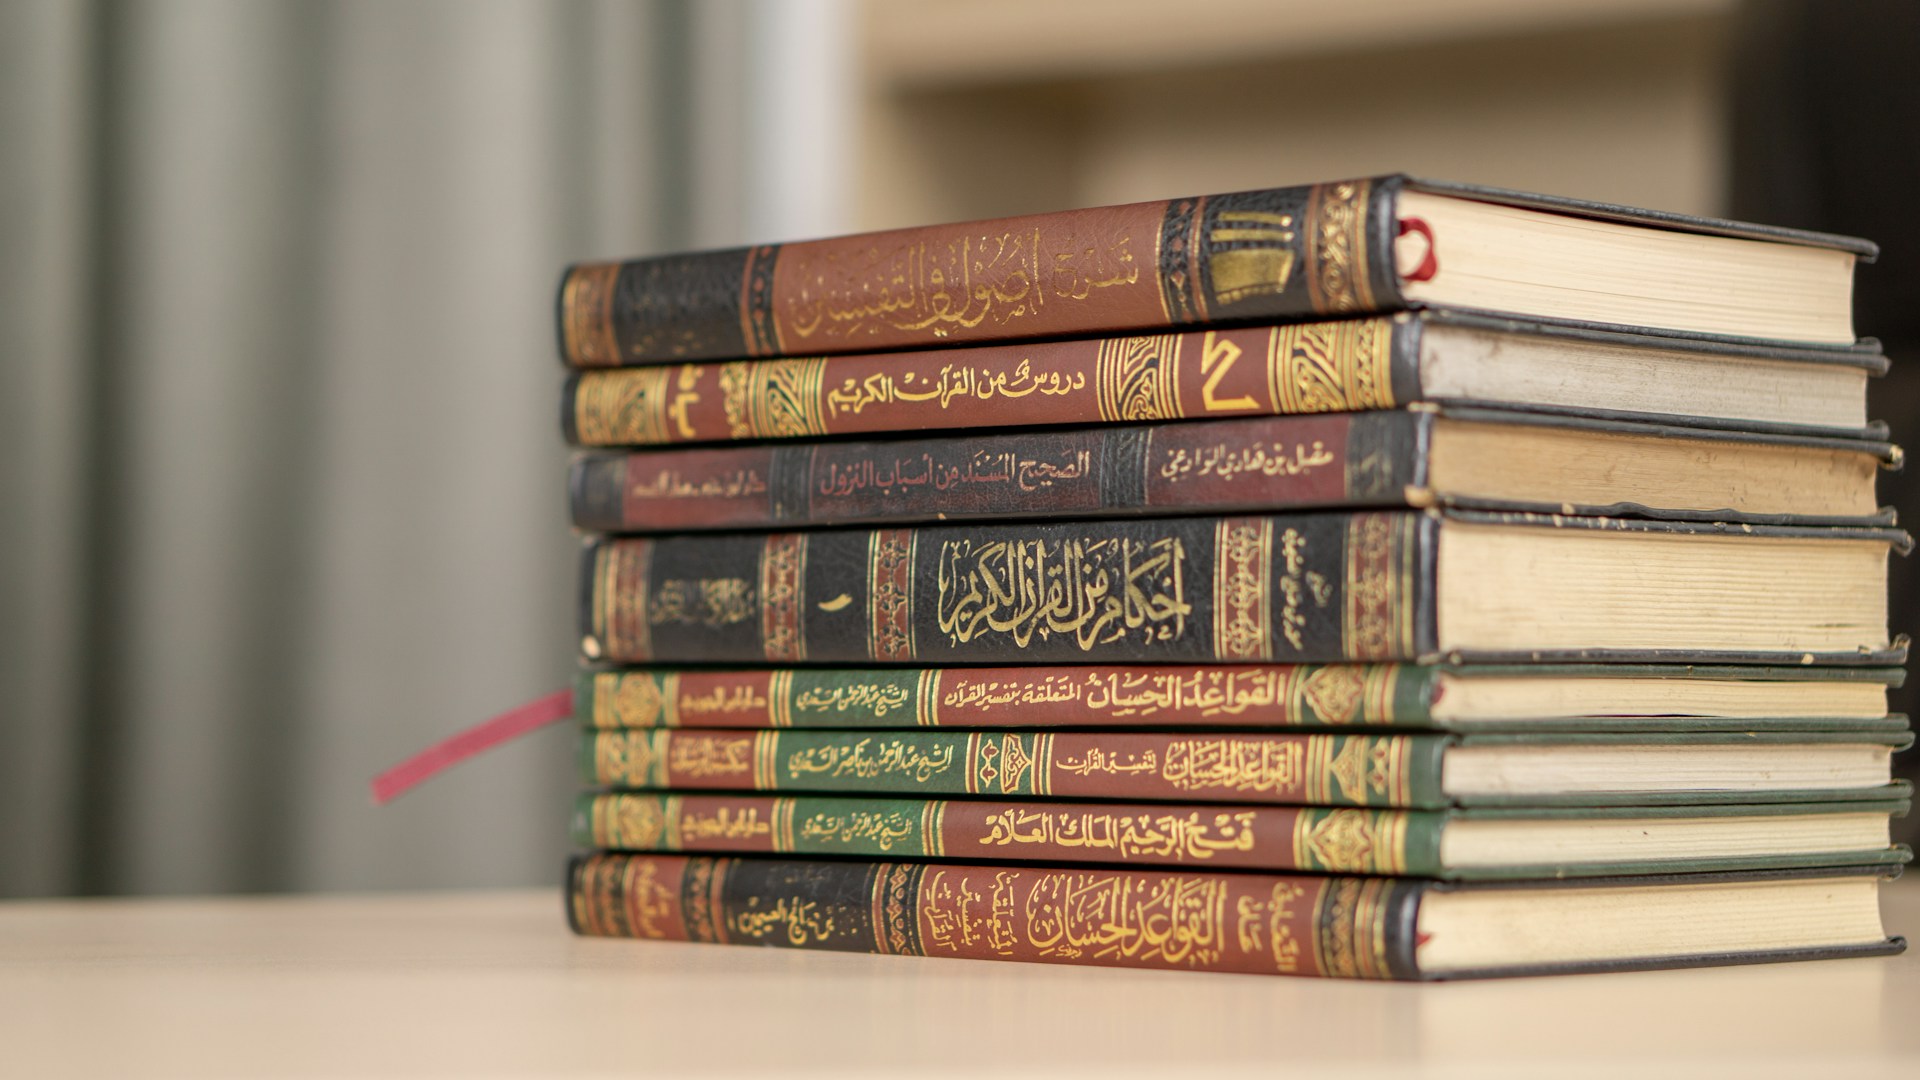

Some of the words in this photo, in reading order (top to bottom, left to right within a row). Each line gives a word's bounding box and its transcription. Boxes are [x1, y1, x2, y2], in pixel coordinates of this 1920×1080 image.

[827, 371, 893, 419] الكريم
[894, 363, 976, 408] القرآن
[977, 367, 1006, 399] من
[1000, 358, 1086, 398] دروس
[820, 459, 874, 497] النزول
[935, 461, 959, 492] من
[1019, 450, 1091, 492] الصحيح
[1263, 443, 1287, 476] بن
[944, 679, 987, 708] القرآن
[975, 682, 1021, 711] بتفسير
[1021, 676, 1081, 705] المتعلقة
[1085, 671, 1182, 716] الحسان
[1183, 669, 1287, 717] القواعد
[916, 744, 954, 782] الشيخ
[1055, 814, 1119, 849] الملك
[1120, 814, 1186, 859] الرحيم
[1186, 811, 1256, 859] فتح
[1026, 873, 1137, 960] الحسان
[1128, 876, 1229, 966] القواعد
